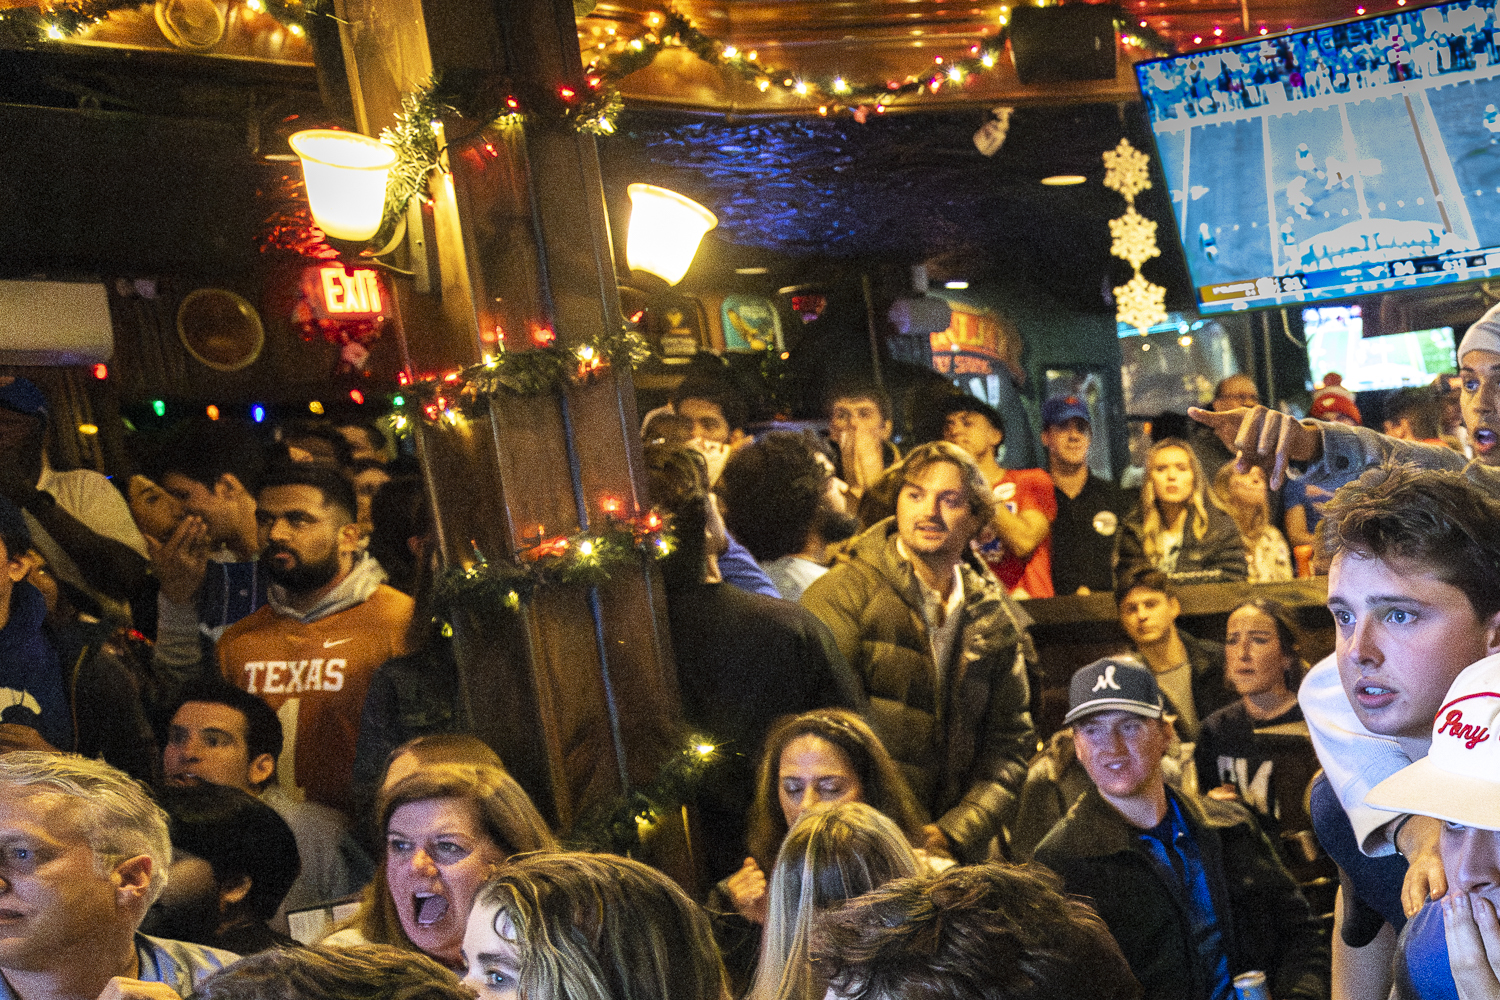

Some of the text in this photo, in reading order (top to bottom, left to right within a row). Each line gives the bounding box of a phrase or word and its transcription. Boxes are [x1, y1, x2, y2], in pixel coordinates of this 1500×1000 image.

[320, 267, 382, 313] EXIT
[244, 658, 348, 694] TEXAS
[1437, 709, 1490, 749] Pony
